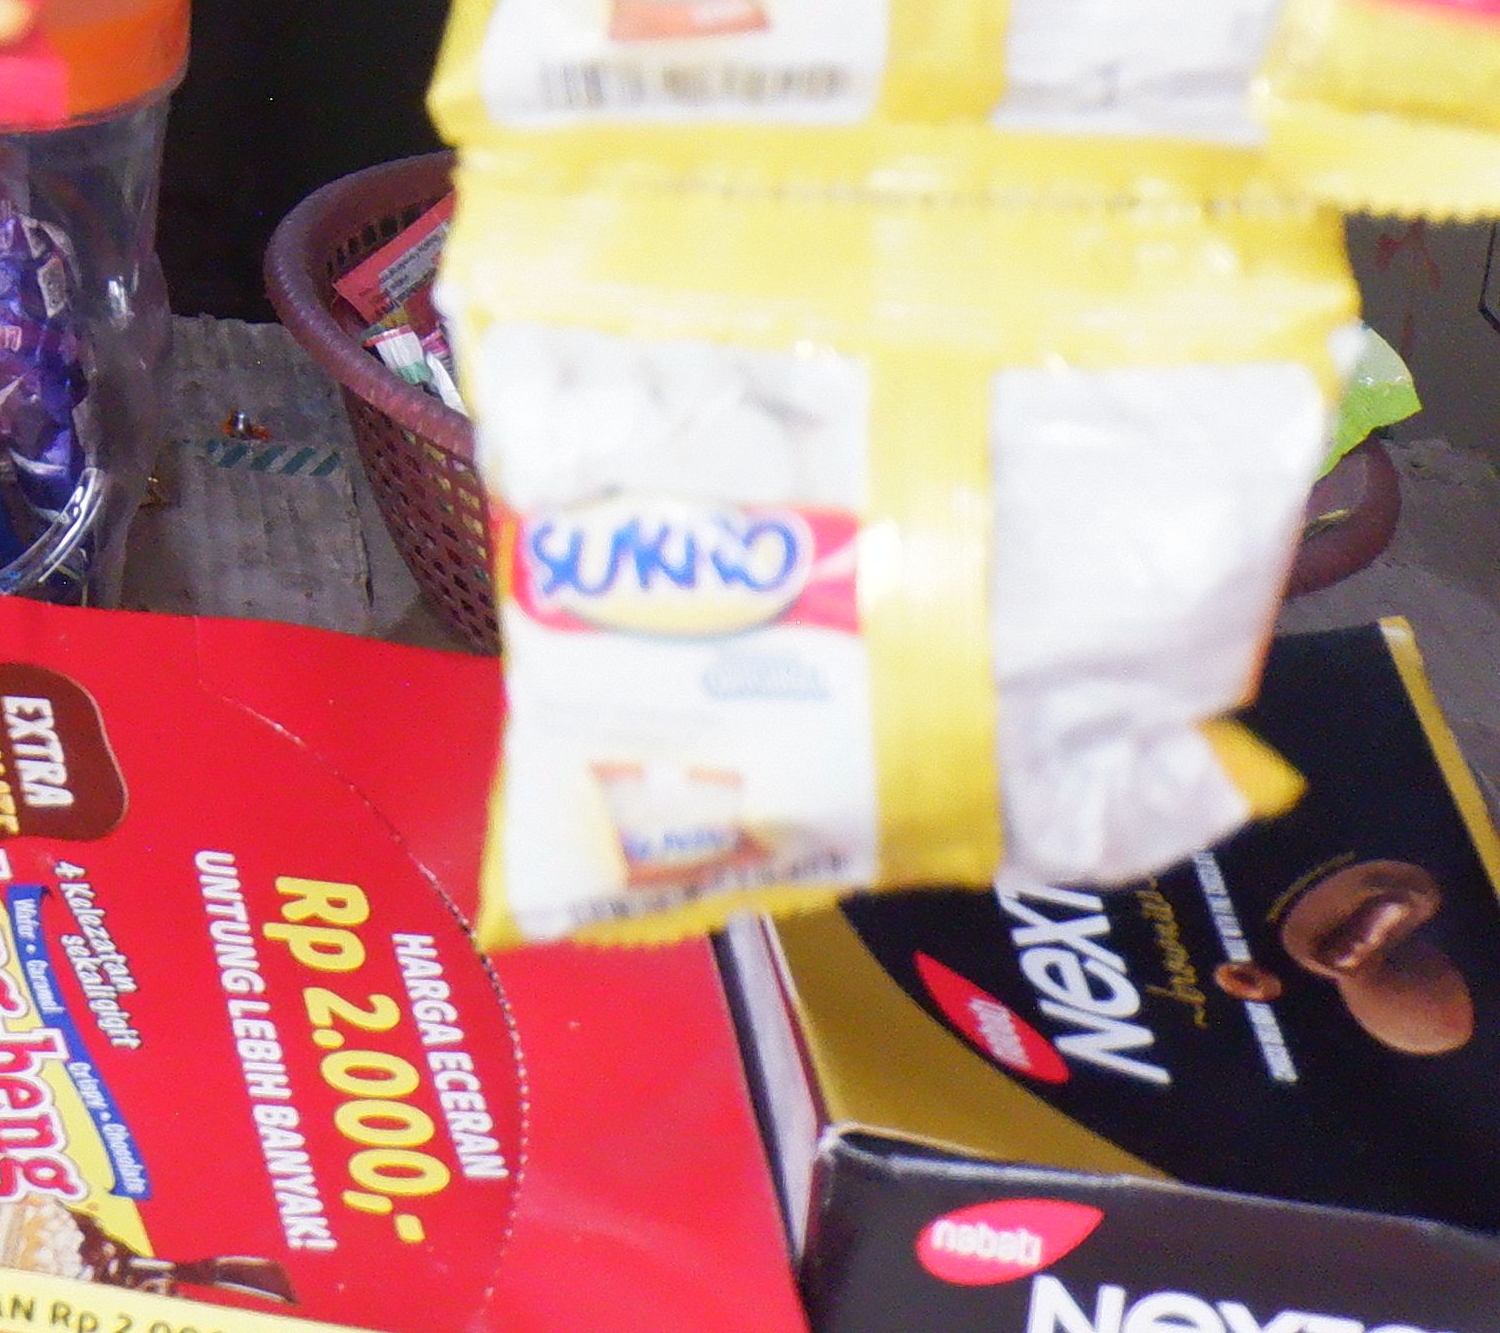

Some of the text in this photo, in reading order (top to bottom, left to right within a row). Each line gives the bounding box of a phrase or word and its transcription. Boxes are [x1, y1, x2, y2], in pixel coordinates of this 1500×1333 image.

[11, 897, 62, 1017] Wafer Caramel
[50, 856, 140, 994] 4 Kelezatan
[269, 874, 374, 974] Rp
[193, 849, 338, 1253] UNTUNG LEBIH BANYAK!
[391, 930, 508, 1181] HARGA ECERAN
[68, 1059, 146, 1198] Crispy Chocolate
[930, 1219, 1043, 1269] nabati
